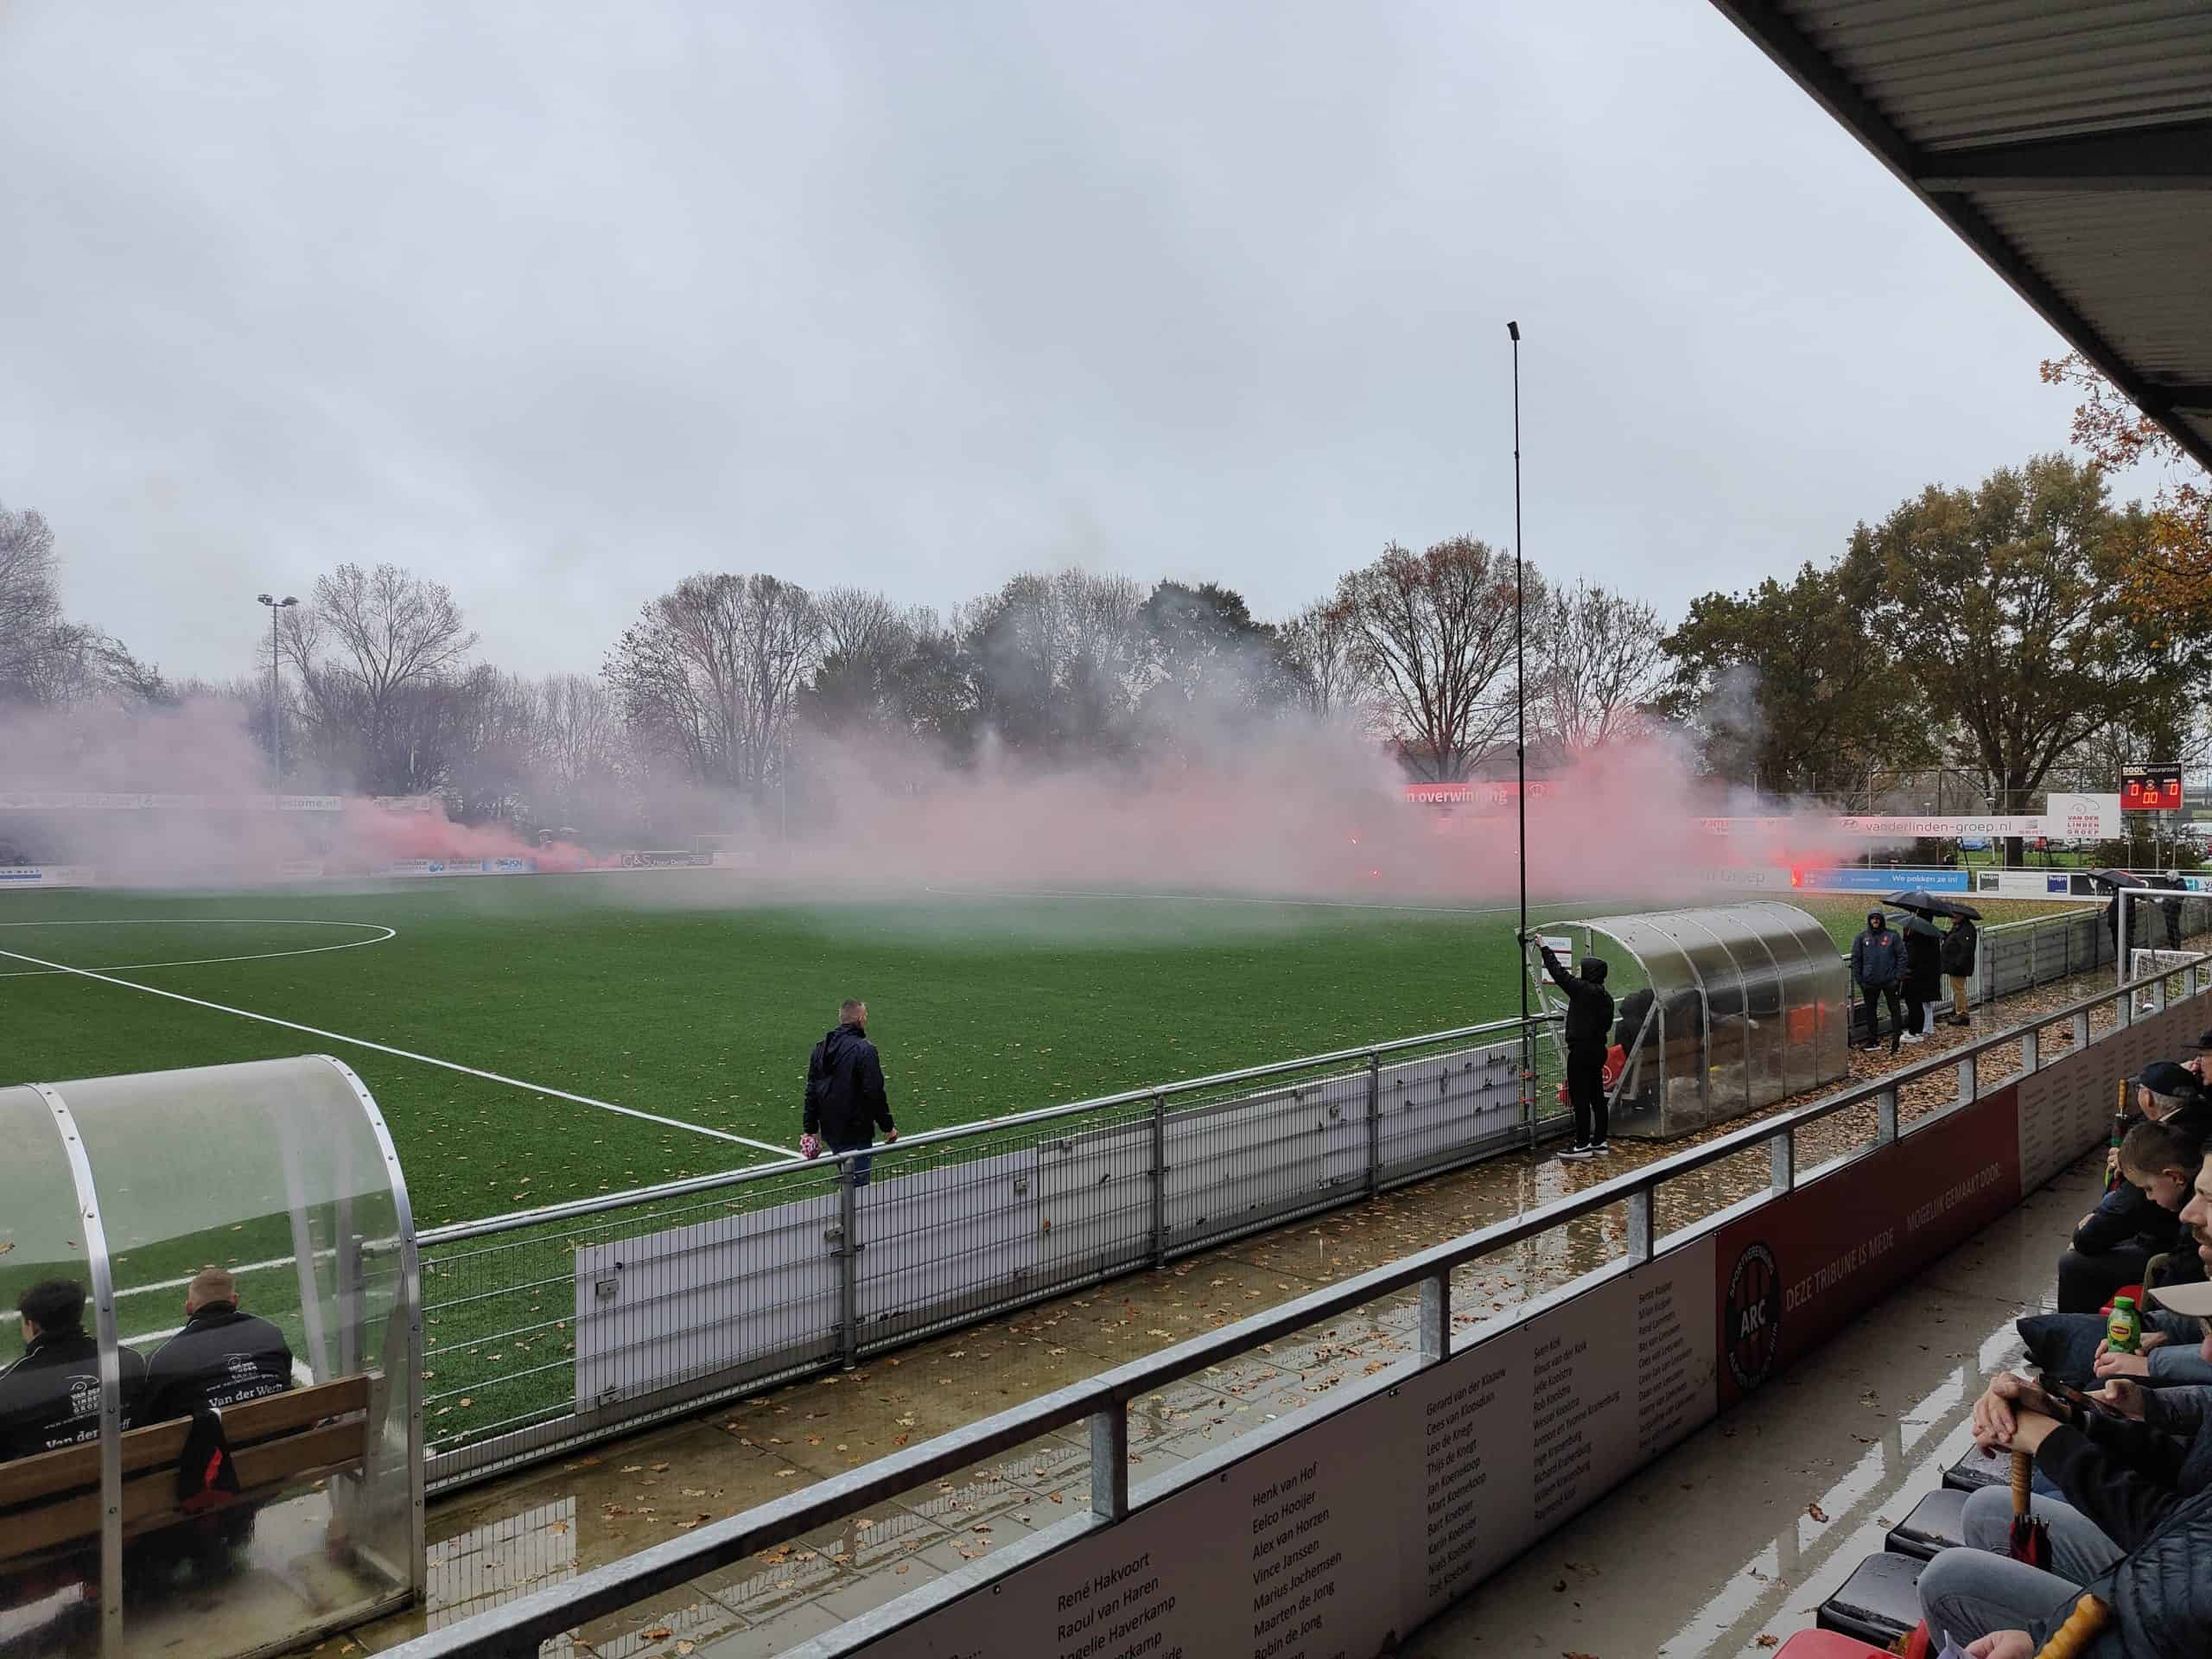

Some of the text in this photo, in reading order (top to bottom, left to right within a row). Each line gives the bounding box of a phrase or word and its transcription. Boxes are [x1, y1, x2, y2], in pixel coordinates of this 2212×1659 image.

[1418, 788, 1507, 804] overwinng
[2131, 784, 2177, 796] 0 0
[2143, 791, 2157, 803] 00
[1866, 822, 2012, 834] vanderlinden-groep.nl
[1786, 1228, 1894, 1313] DEZE TRIBUNE IS MEDE
[1741, 1300, 1765, 1338] ARC
[72, 1395, 98, 1407] LINDE
[73, 1403, 97, 1413] GROE
[208, 1395, 232, 1407] Van
[236, 1389, 255, 1400] der
[1426, 1391, 1452, 1416] Gerard
[1453, 1387, 1467, 1402] van
[1468, 1379, 1480, 1395] der
[1427, 1419, 1445, 1436] Cees
[1446, 1410, 1459, 1425] van
[1427, 1440, 1443, 1457] Leo
[1442, 1433, 1452, 1446] de
[1427, 1458, 1445, 1477] Thijs
[1446, 1451, 1455, 1465] de
[1252, 1461, 1319, 1507] Henk van Hof
[1427, 1481, 1440, 1498] Jan
[1252, 1491, 1316, 1534] Eelco Hooijer
[1427, 1497, 1446, 1516] Mart
[1253, 1508, 1329, 1560] Alex van Horzen
[1427, 1520, 1443, 1537] Bart
[1253, 1539, 1319, 1585] Vince Janssen
[1058, 1552, 1150, 1612] René Hakvoort
[1254, 1552, 1342, 1612] Marius Jochemsen
[1058, 1576, 1159, 1642] Raoul van Haren
[1109, 1595, 1175, 1643] Haverkamp
[1254, 1581, 1335, 1639] Maarten de Jong
[1114, 1630, 1162, 1659] erkamp
[1255, 1614, 1322, 1659] Robin de Jong
